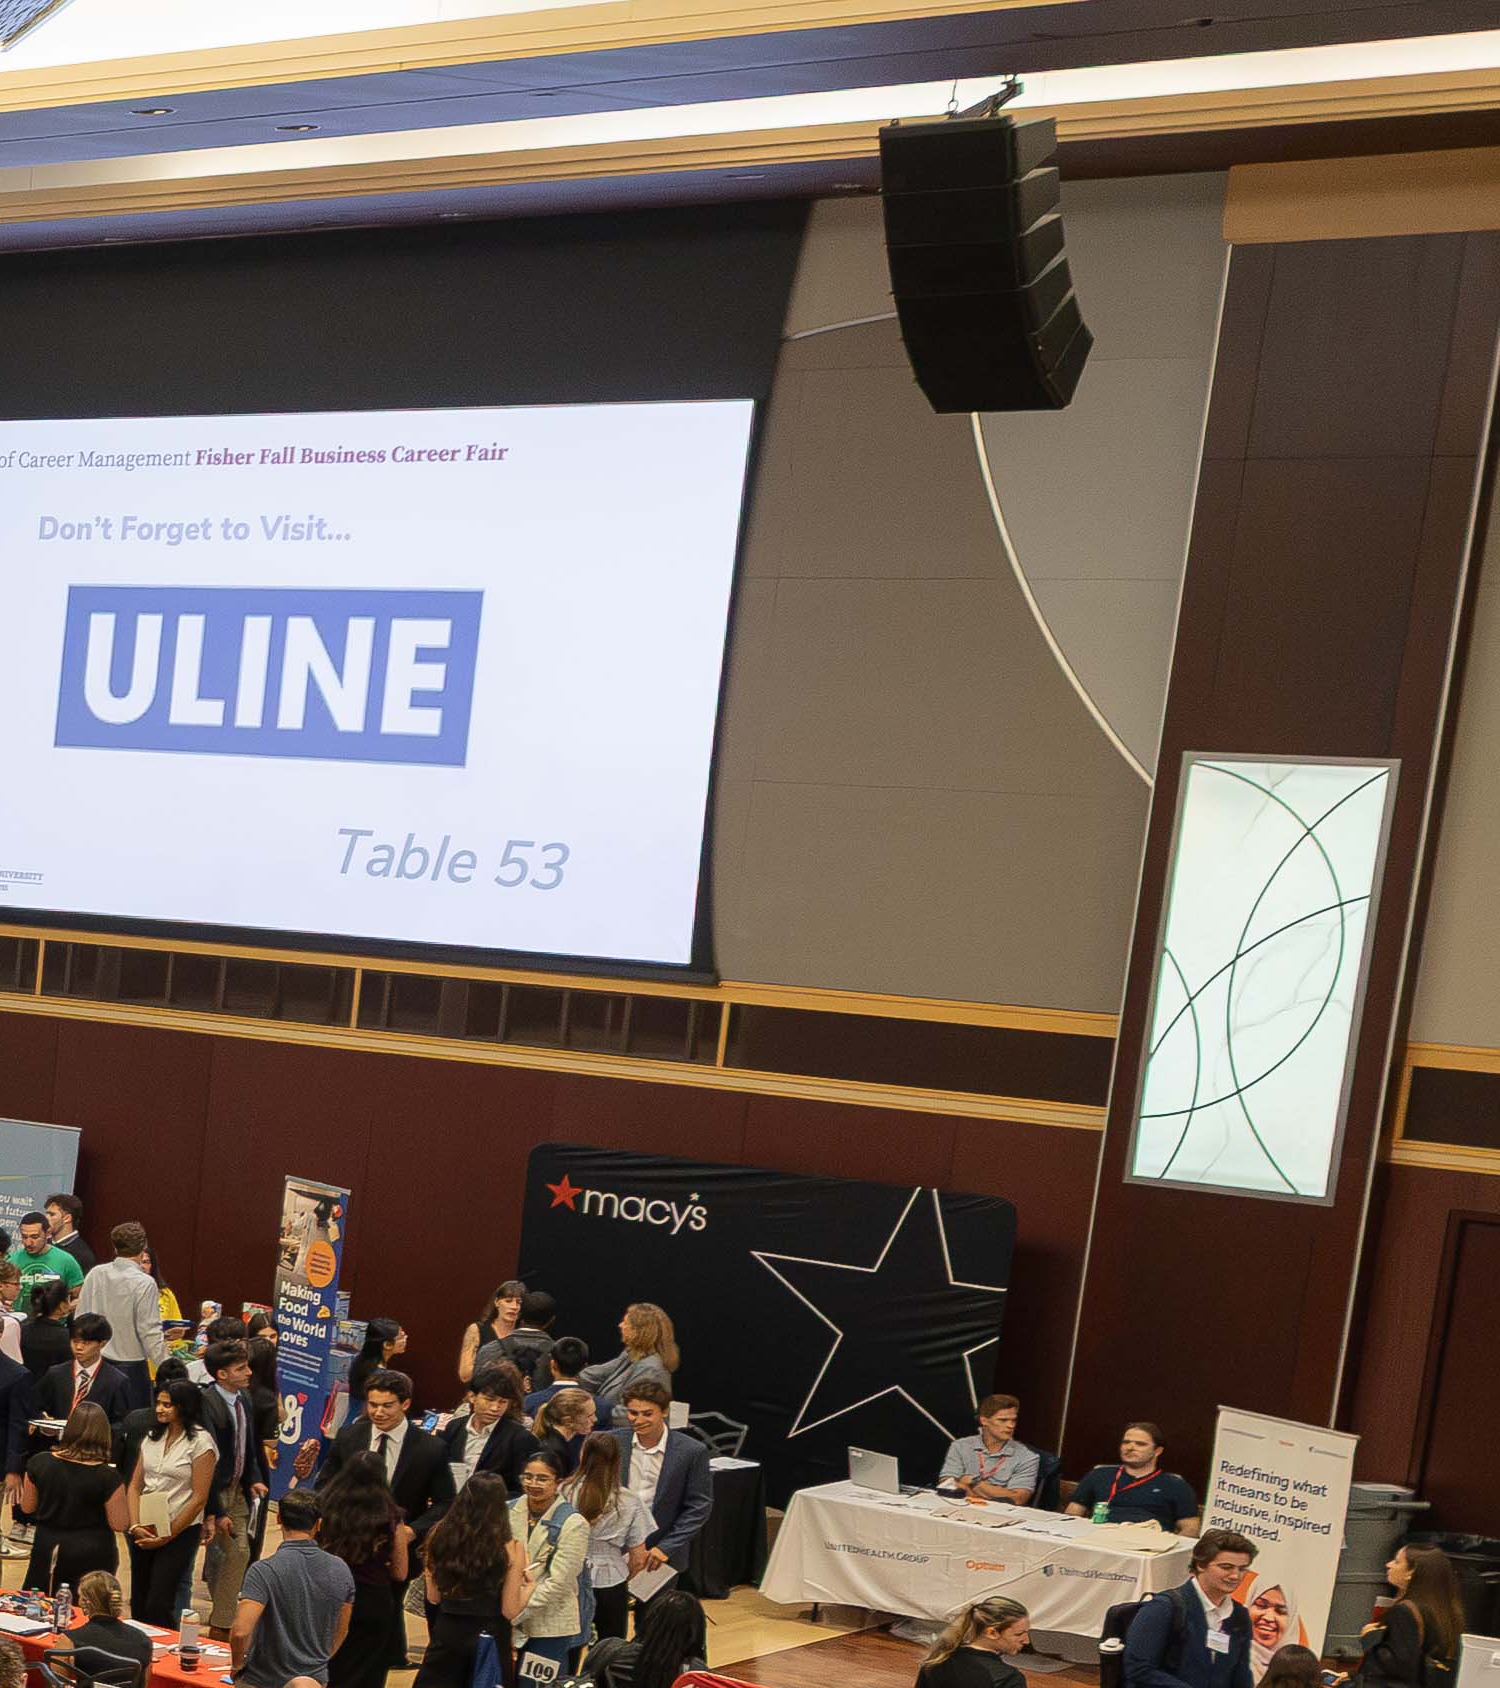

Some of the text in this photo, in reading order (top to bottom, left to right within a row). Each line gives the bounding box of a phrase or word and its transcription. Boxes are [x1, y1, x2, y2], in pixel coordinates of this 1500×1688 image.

[18, 450, 74, 468] Career
[78, 449, 192, 471] Management
[195, 446, 255, 466] Fisher
[259, 446, 296, 465] Fall
[300, 444, 386, 464] Business
[391, 444, 461, 463] Career
[466, 443, 510, 462] Fair
[38, 515, 352, 546] Don't Forget to Visit...
[83, 613, 453, 736] ULINE
[337, 827, 571, 890] Table 53
[12, 1196, 33, 1206] wait
[279, 1298, 308, 1317] Food
[281, 1281, 321, 1306] Making
[292, 1317, 326, 1339] World
[1220, 1460, 1328, 1497] Redefining what
[1217, 1477, 1308, 1511] it means to be
[1210, 1515, 1282, 1543] and united.
[1214, 1495, 1331, 1535] inclusive, inspired
[526, 1660, 554, 1681] 109
